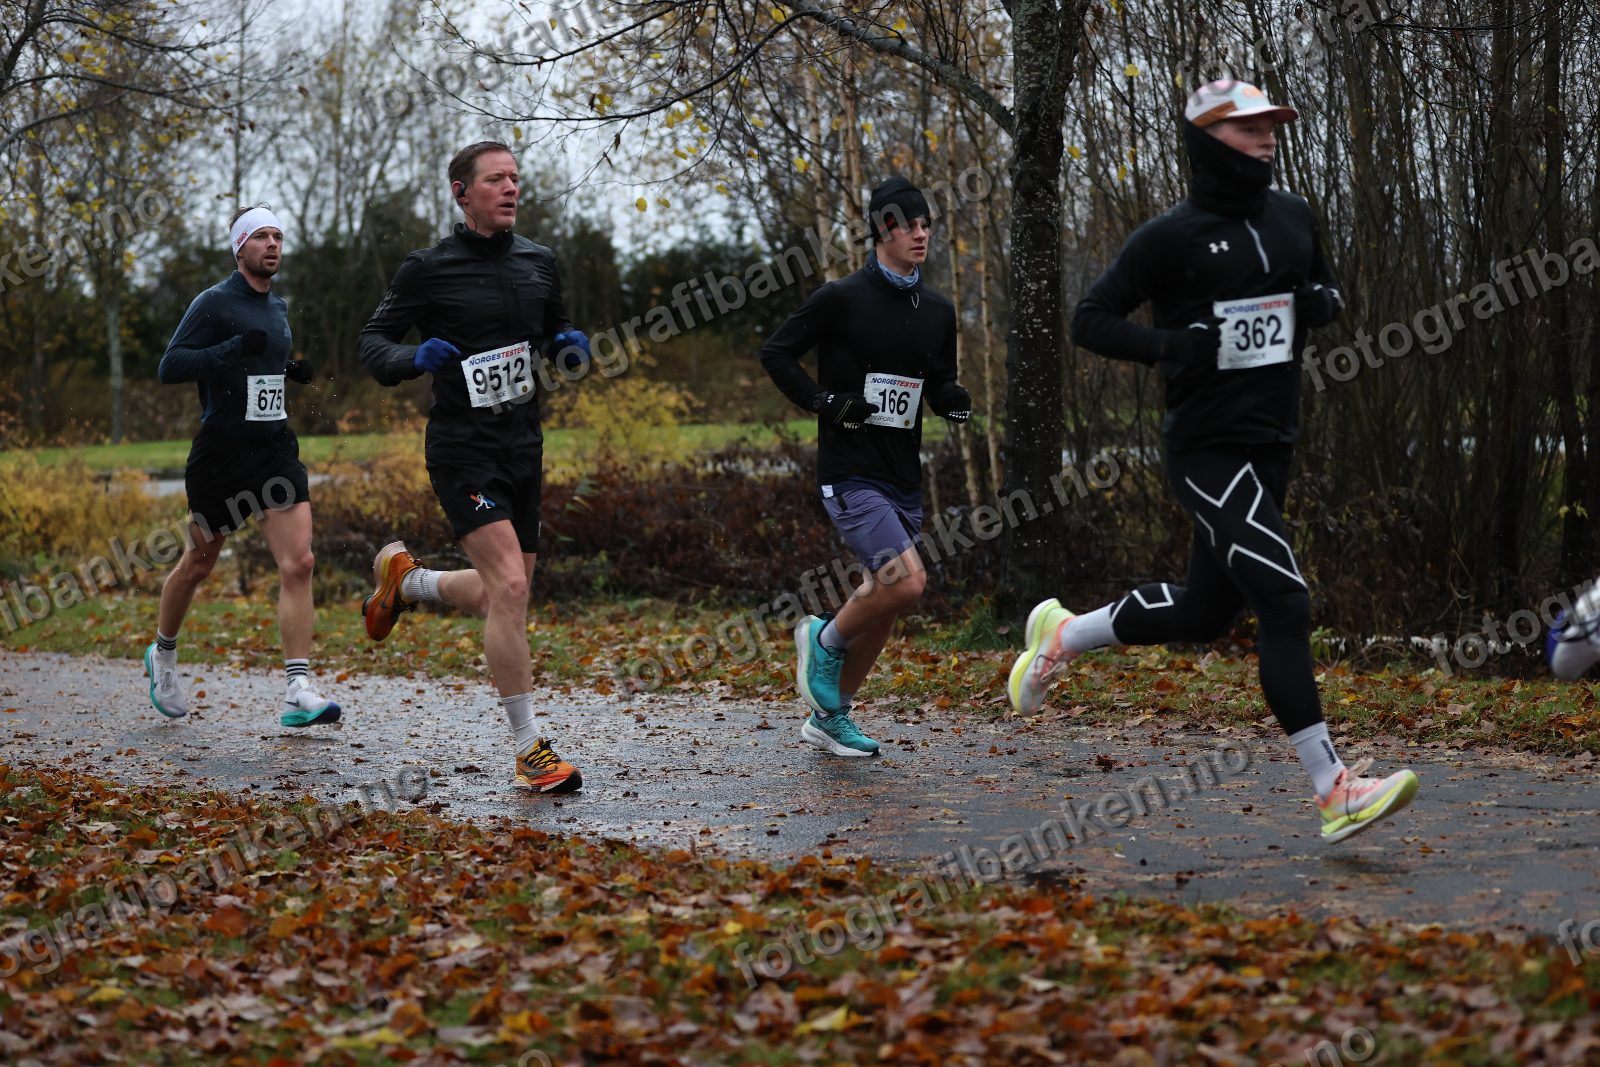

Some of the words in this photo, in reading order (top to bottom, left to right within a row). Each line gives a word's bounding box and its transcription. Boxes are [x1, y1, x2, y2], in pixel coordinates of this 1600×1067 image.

[1234, 314, 1286, 351] 362
[472, 357, 526, 394] 9512
[258, 389, 282, 411] 675
[878, 388, 911, 415] 166
